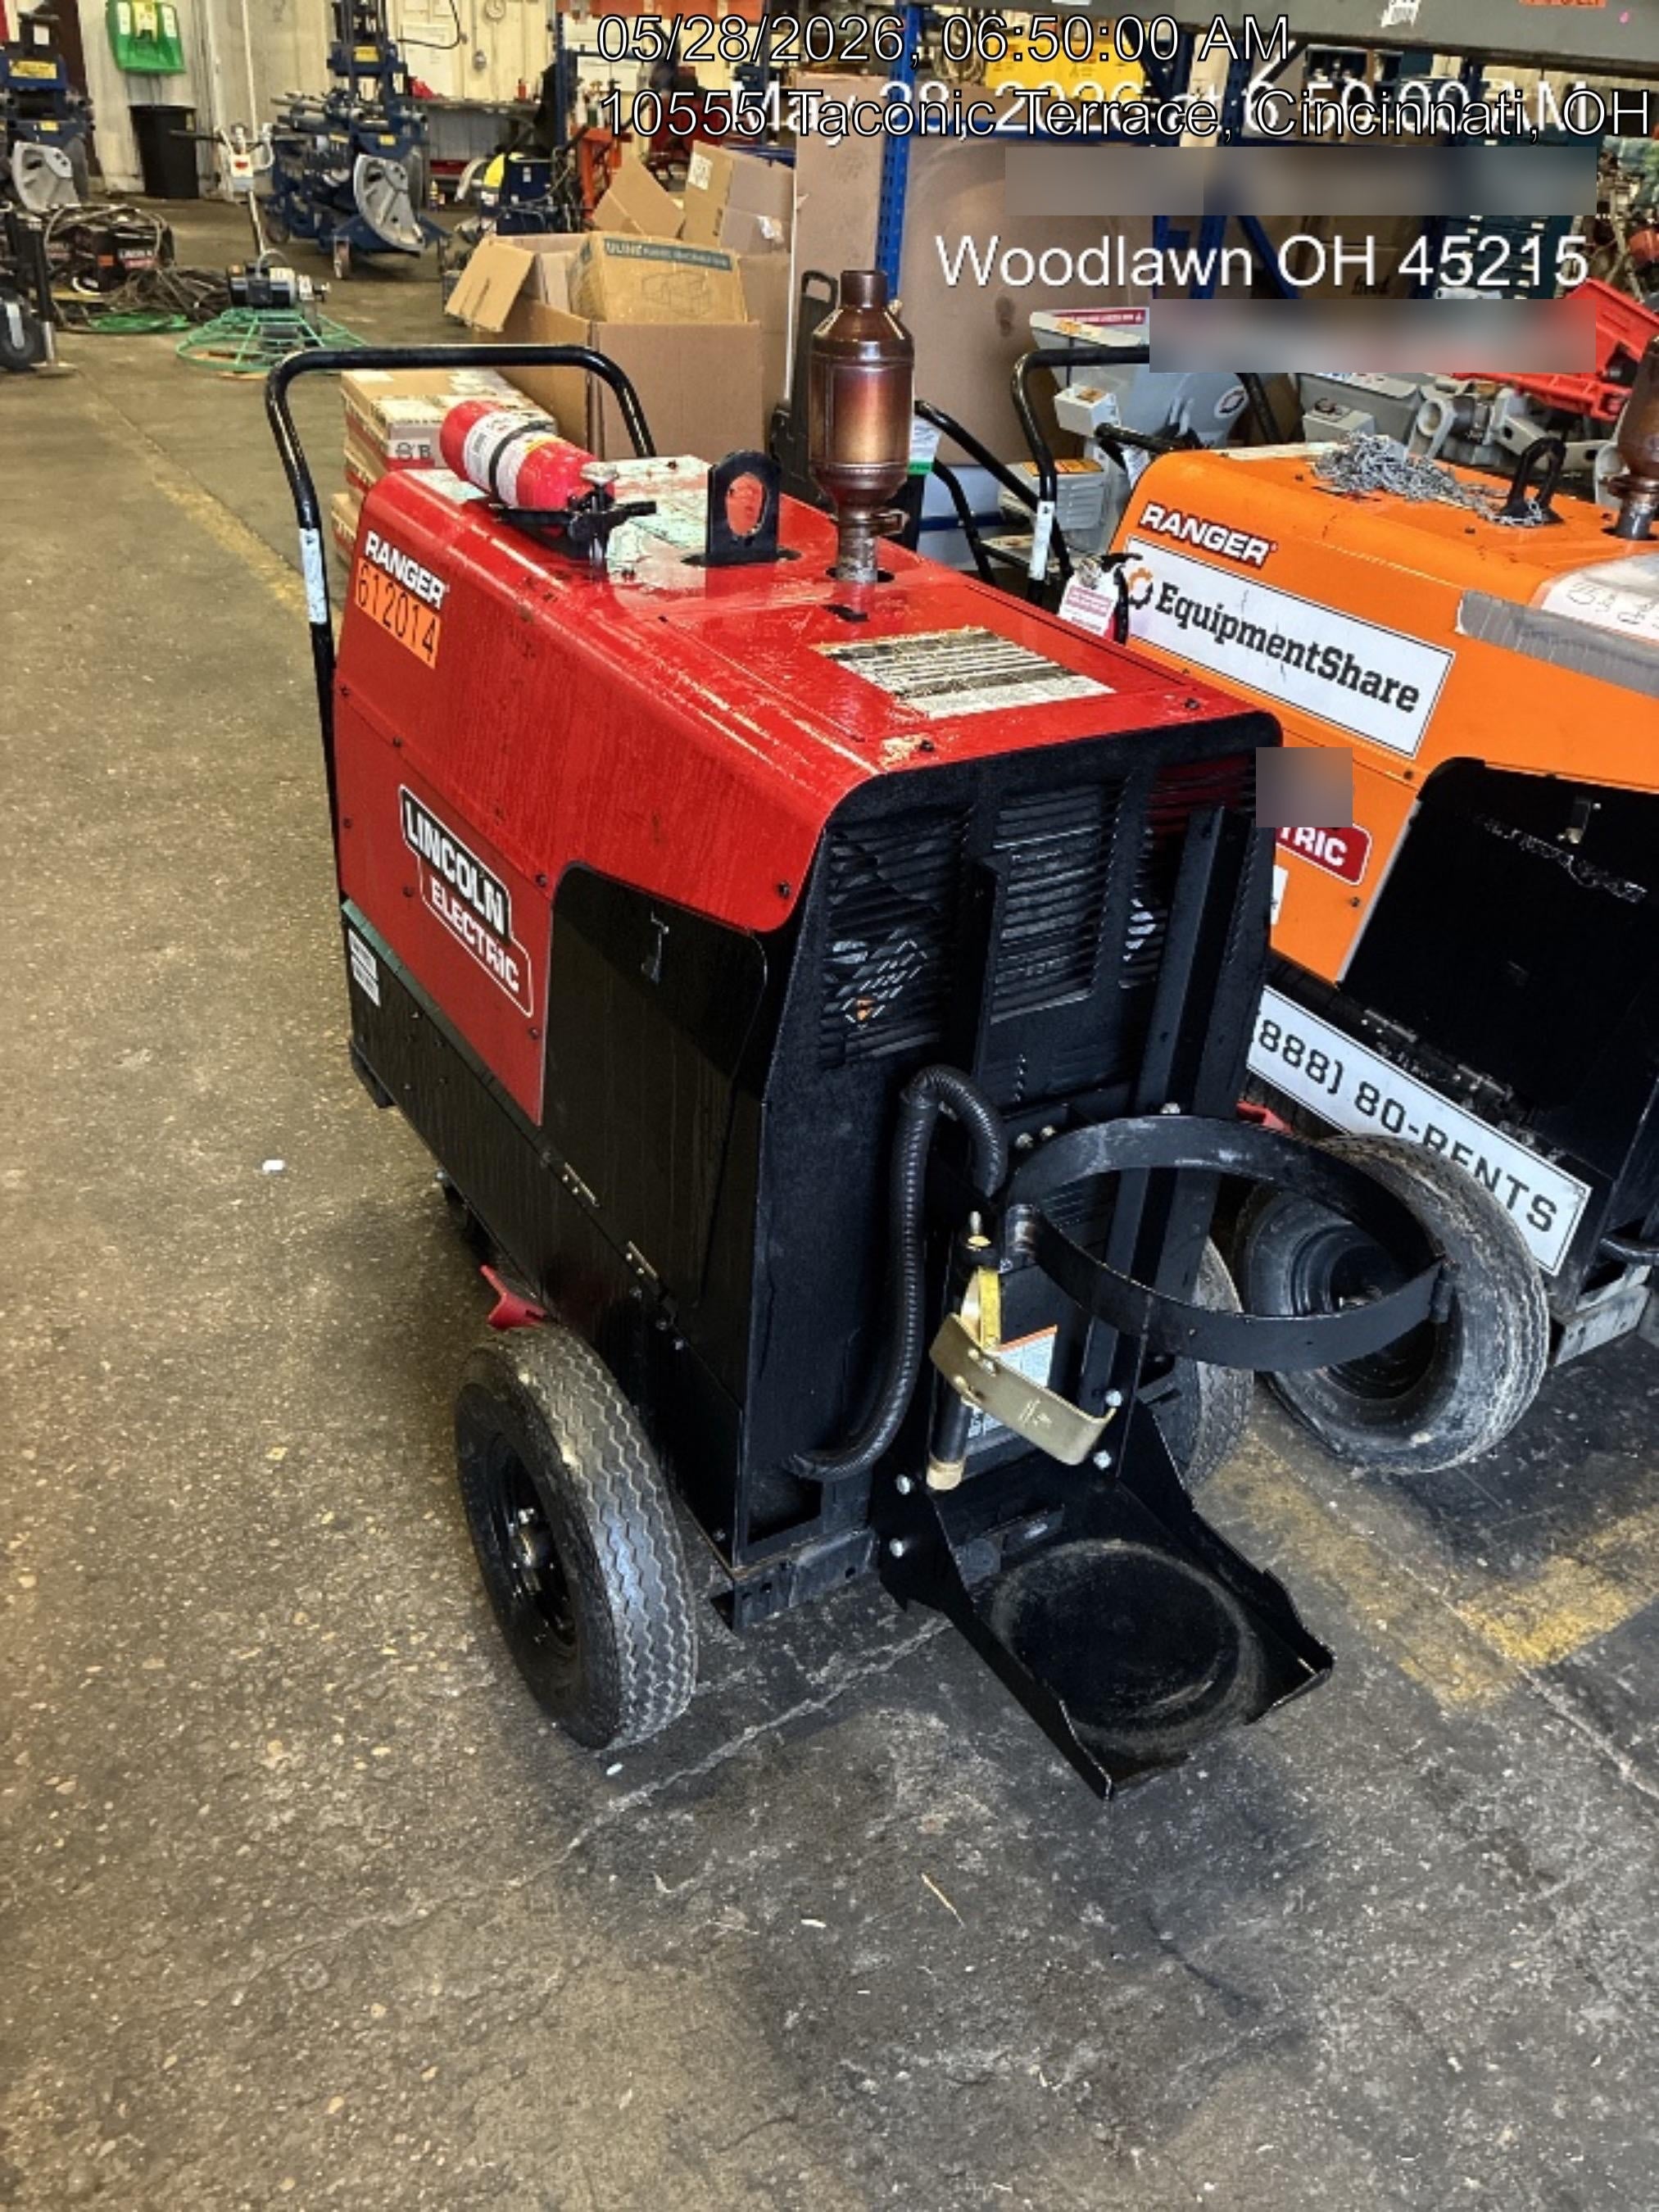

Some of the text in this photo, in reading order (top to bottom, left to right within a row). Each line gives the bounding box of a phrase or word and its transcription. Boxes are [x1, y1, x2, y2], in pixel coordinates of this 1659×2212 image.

[365, 529, 446, 610] RANGER
[1140, 503, 1271, 567] RANGER
[1154, 582, 1420, 714] EquipmentShare
[405, 800, 505, 936] LINCOLN
[428, 873, 520, 994] ELECTRIC
